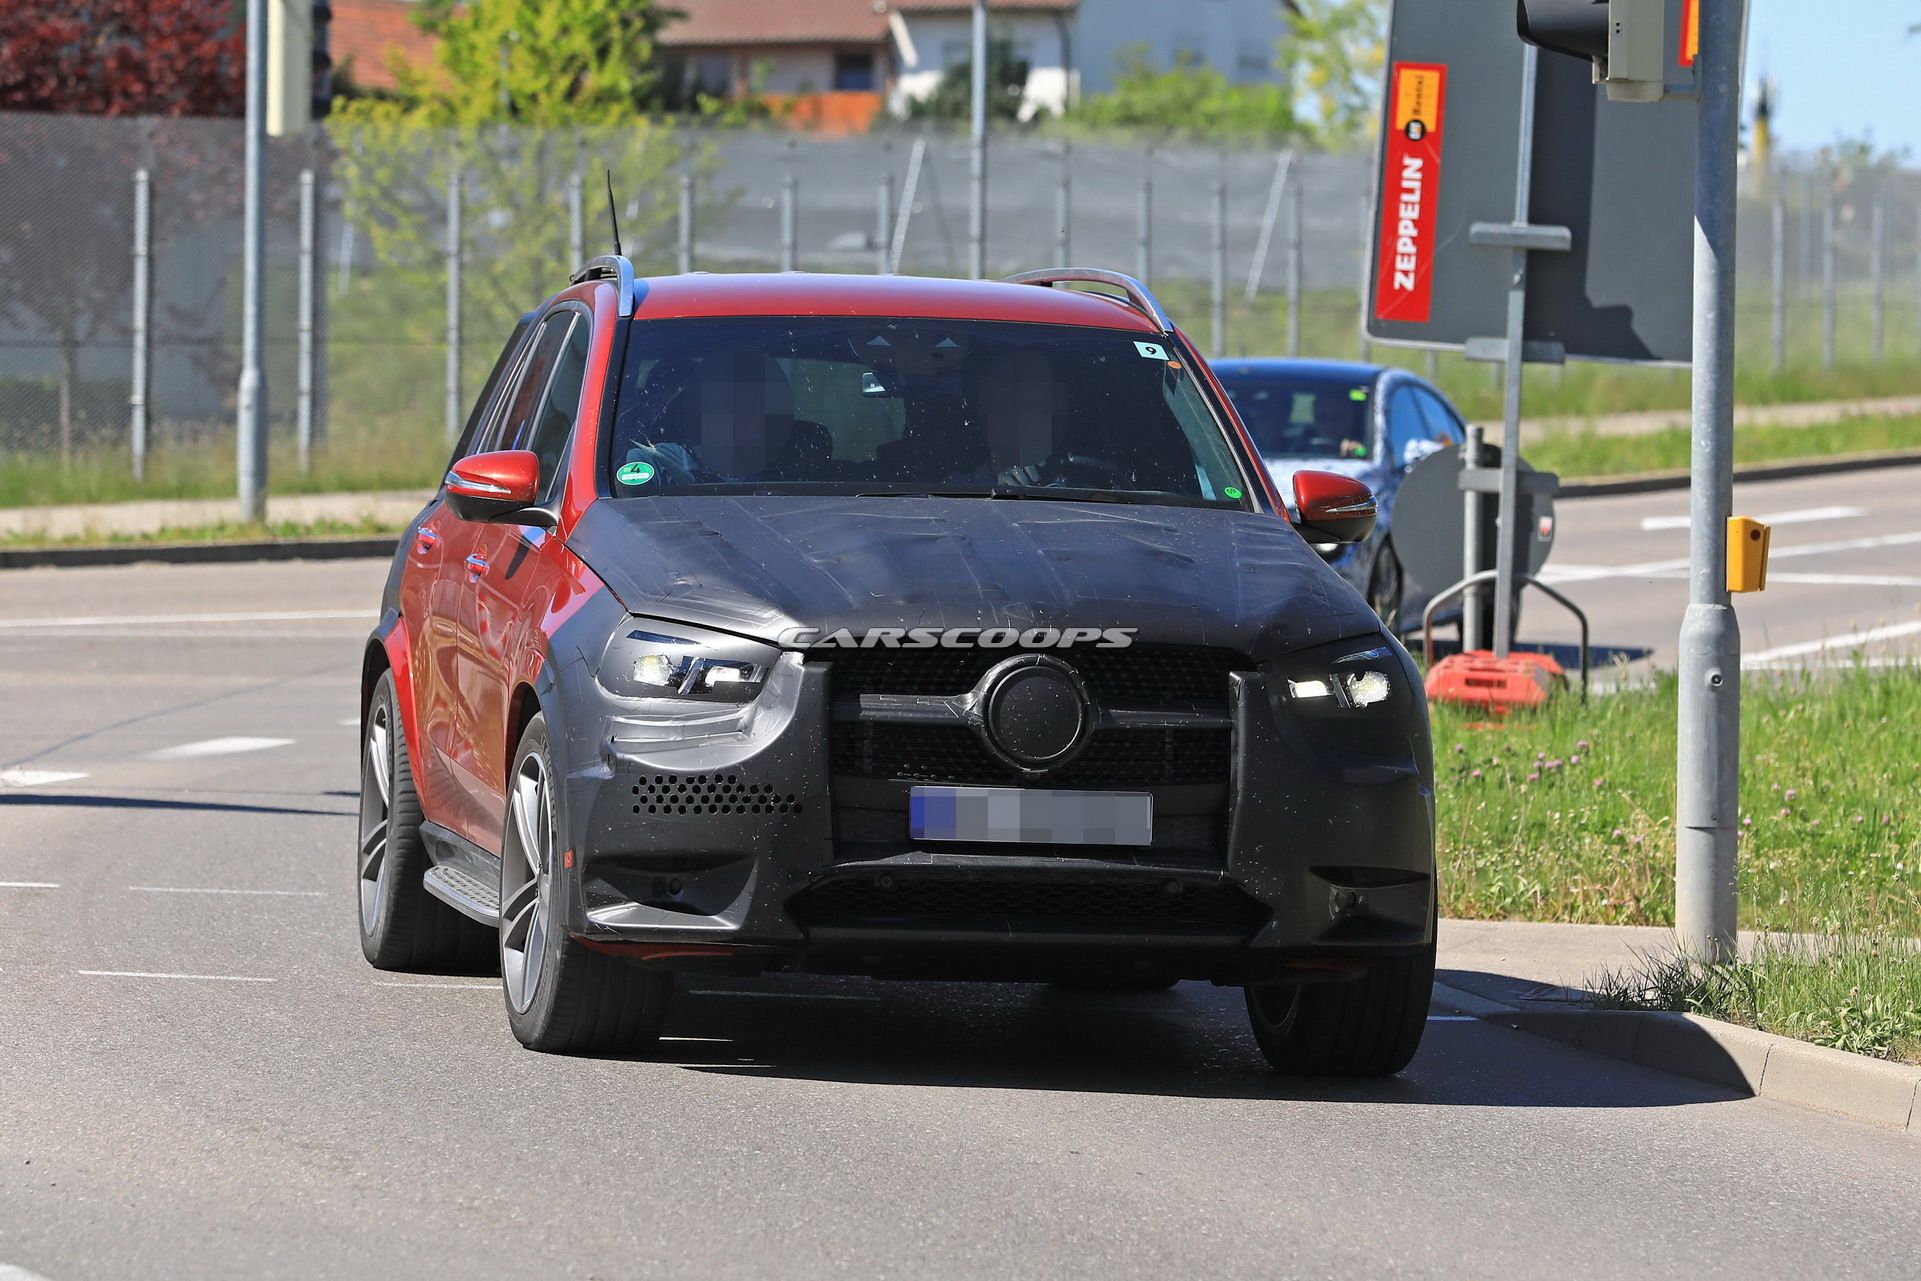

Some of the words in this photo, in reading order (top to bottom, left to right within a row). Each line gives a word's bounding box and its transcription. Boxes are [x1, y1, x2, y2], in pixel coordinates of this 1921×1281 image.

[1394, 157, 1424, 292] ZEPPELIN
[1145, 346, 1157, 355] 9
[631, 464, 640, 473] 4
